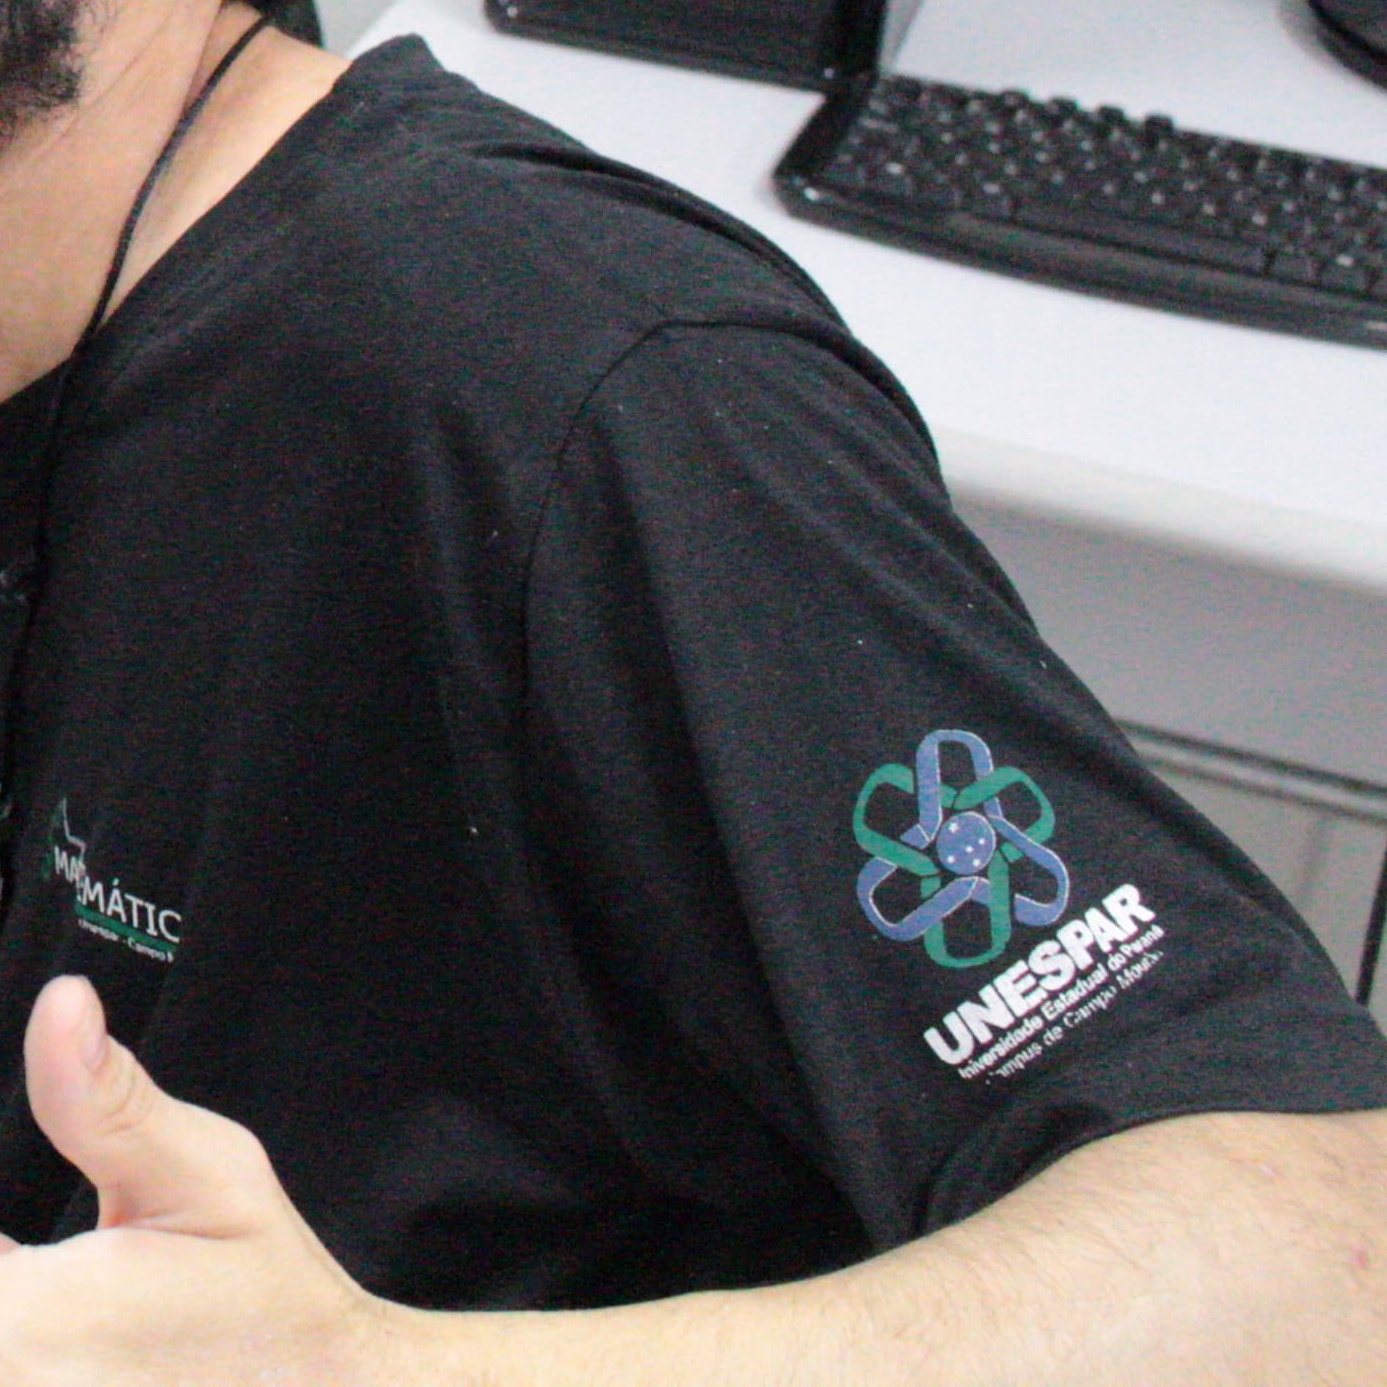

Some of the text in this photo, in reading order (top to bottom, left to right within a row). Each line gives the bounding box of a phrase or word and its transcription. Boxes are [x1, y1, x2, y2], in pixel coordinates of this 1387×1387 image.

[54, 845, 182, 943] MAMÁTIC
[923, 884, 1155, 1065] UNESPAR
[1040, 963, 1108, 1020] Estadual
[1107, 952, 1126, 971] do
[1043, 1026, 1064, 1046] de
[1063, 985, 1117, 1027] Campo
